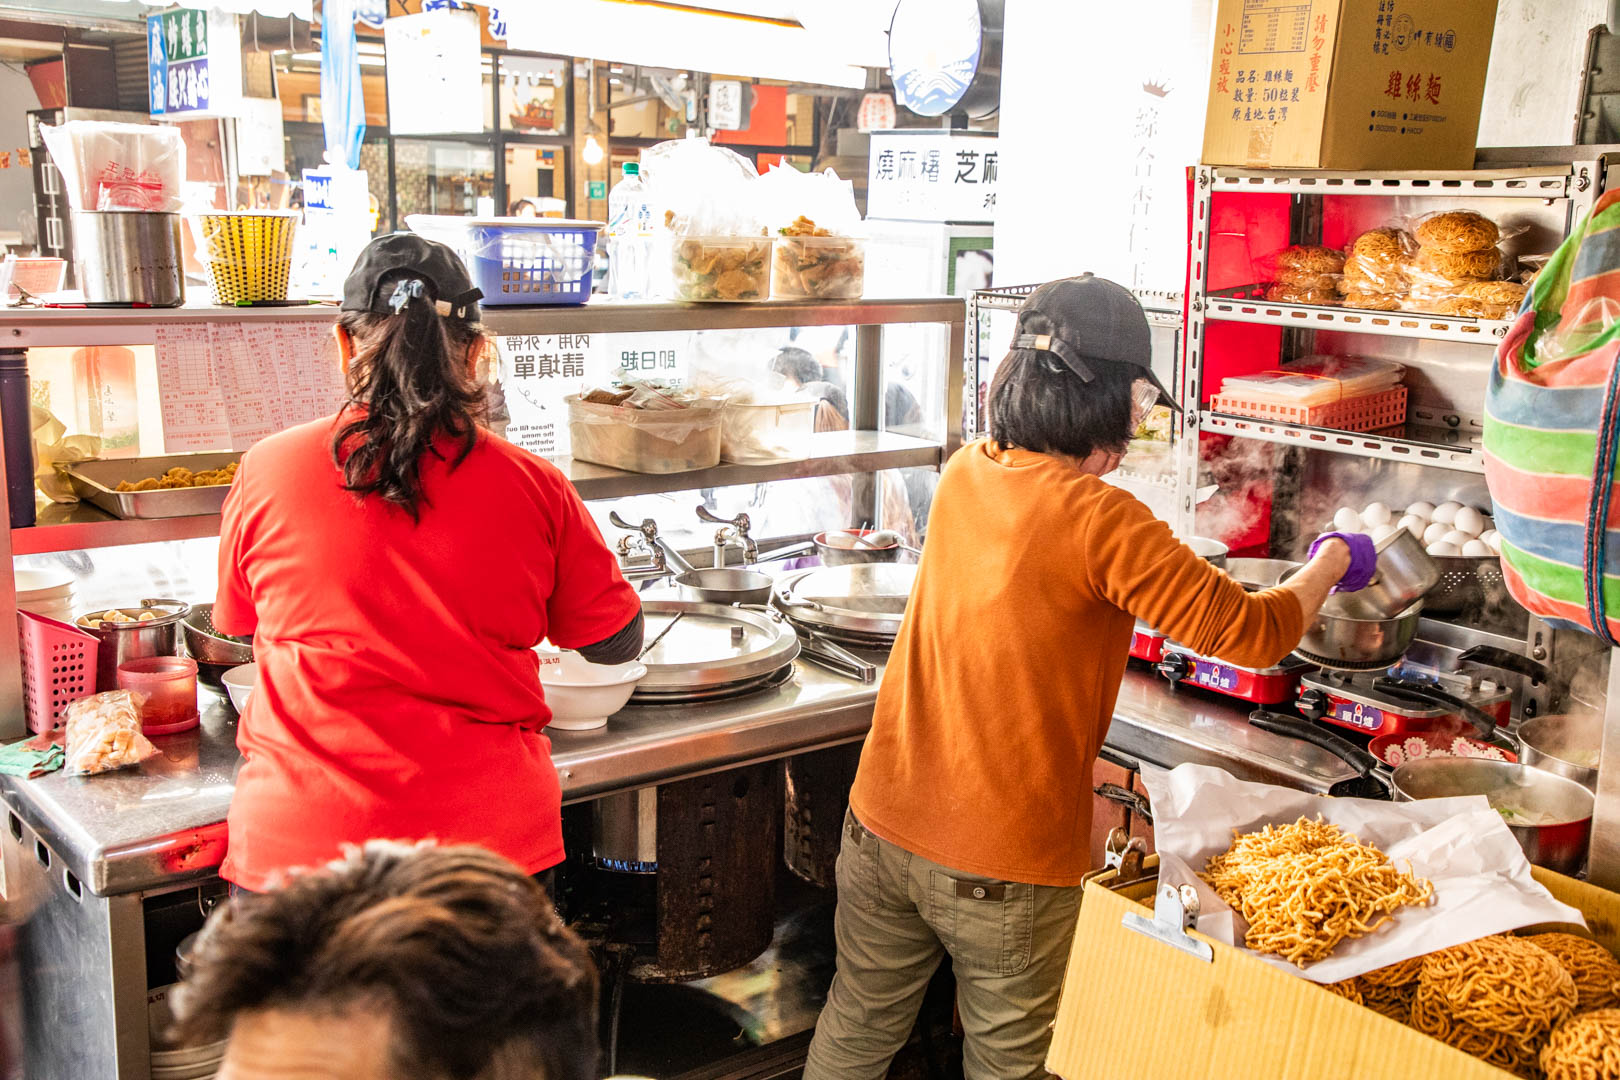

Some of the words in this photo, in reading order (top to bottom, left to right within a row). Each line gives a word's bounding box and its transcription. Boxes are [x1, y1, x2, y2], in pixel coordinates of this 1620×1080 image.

[1215, 23, 1236, 93] 小心輕放
[1305, 13, 1329, 93] 請勿重壓
[1384, 70, 1442, 106] 雞絲麵
